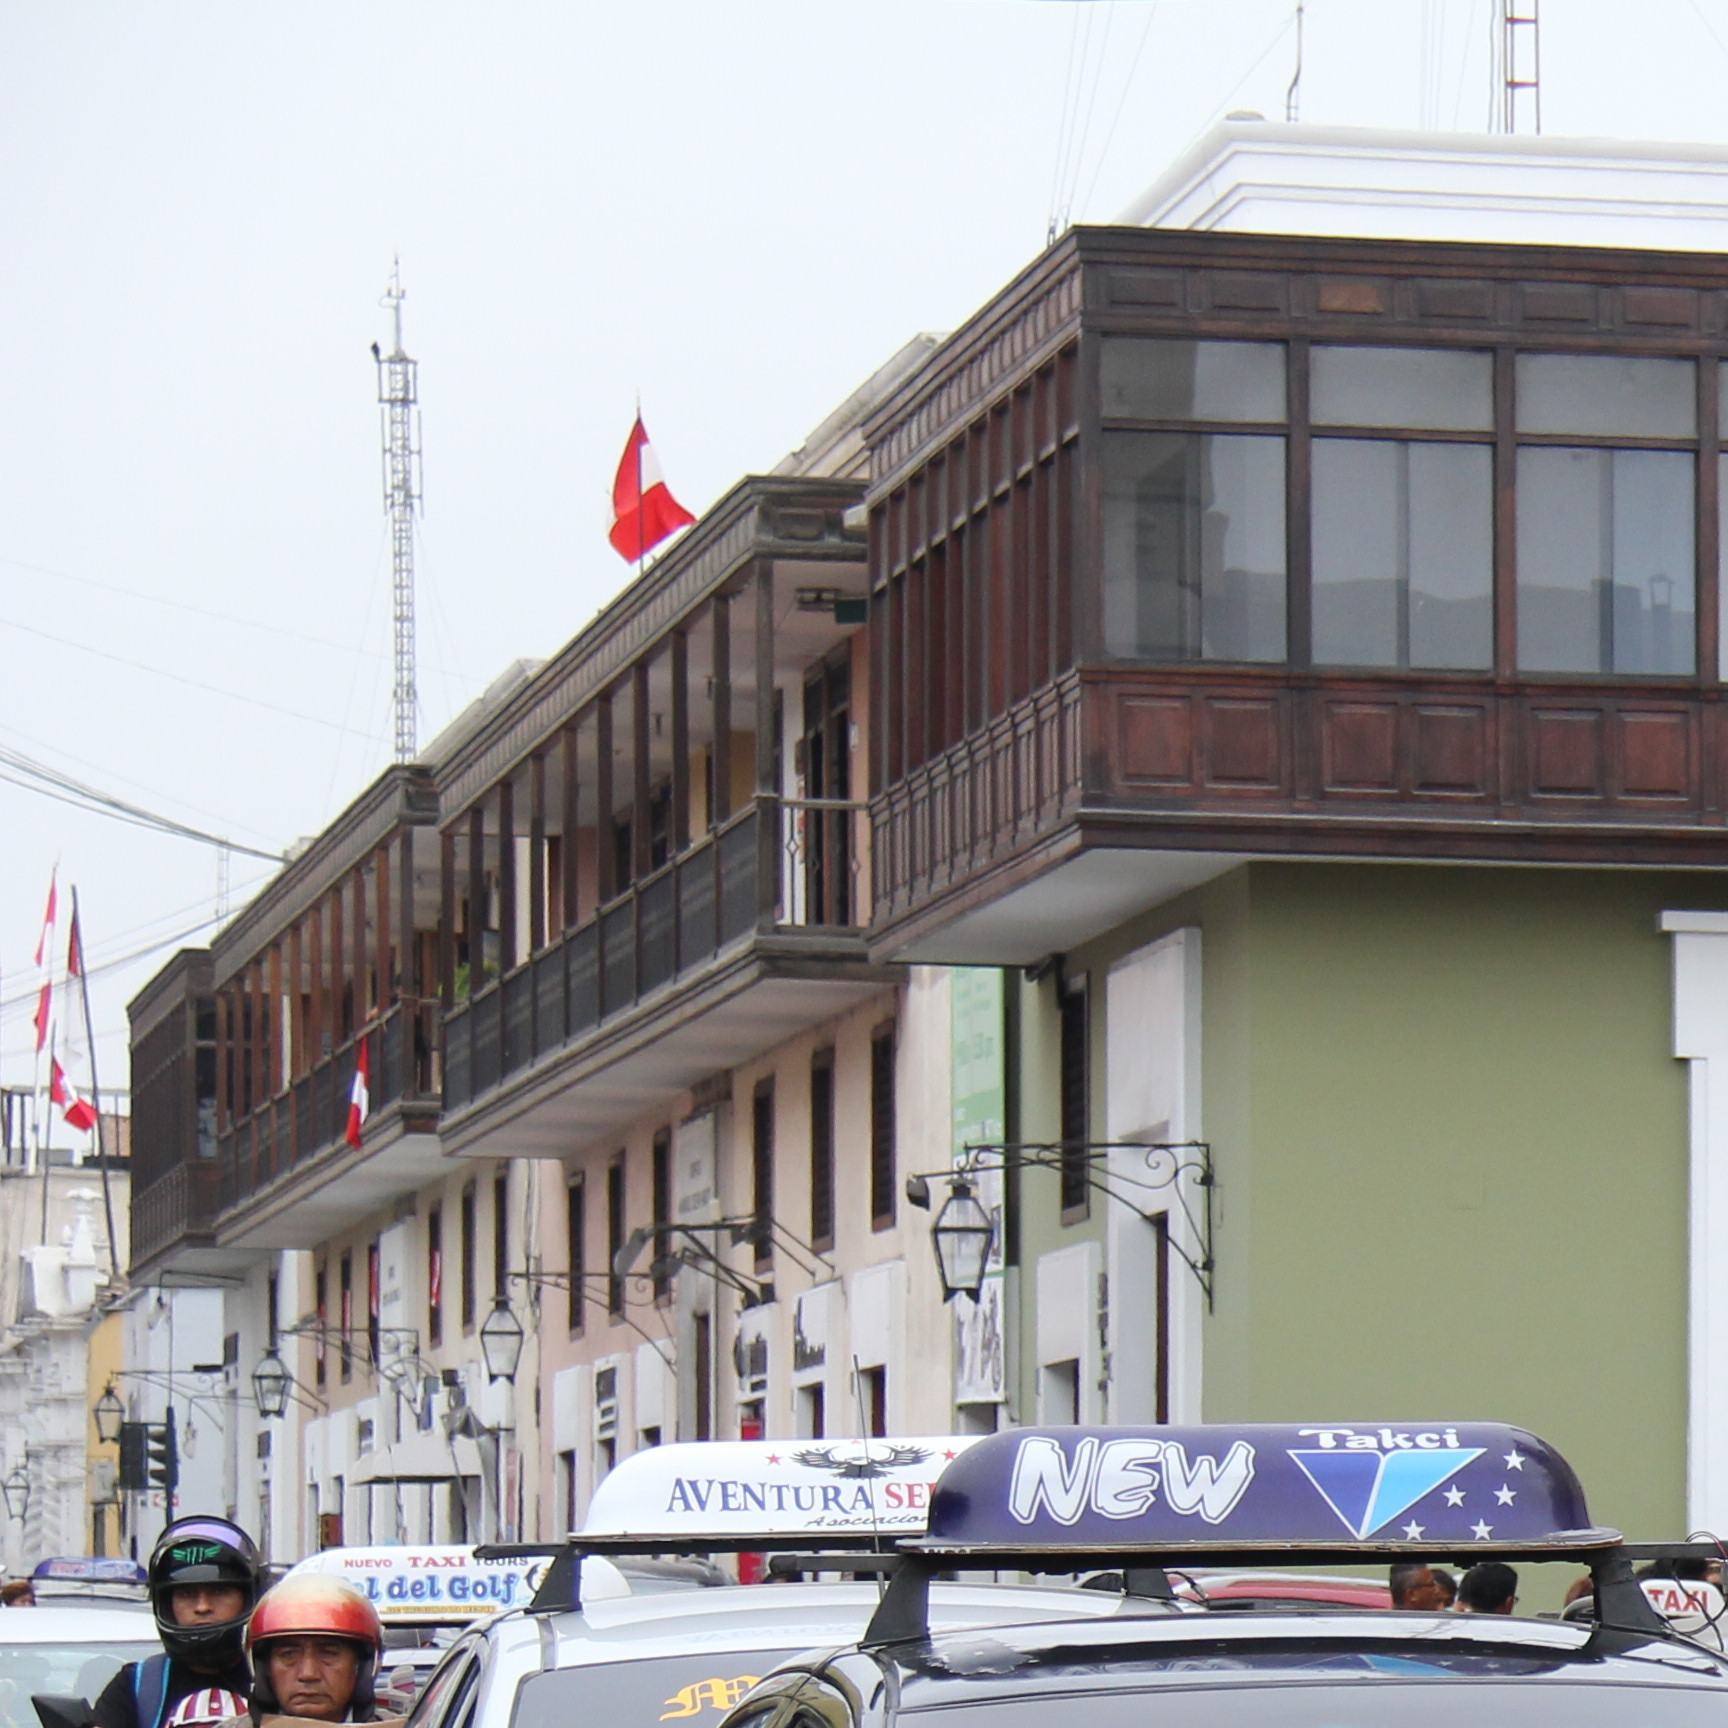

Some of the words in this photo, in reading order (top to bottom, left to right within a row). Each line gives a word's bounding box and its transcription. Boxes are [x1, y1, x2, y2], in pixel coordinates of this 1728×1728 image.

[1297, 1428, 1460, 1450] Takci
[1009, 1436, 1256, 1526] NEW
[665, 1477, 873, 1515] AVENTURA
[344, 1558, 393, 1569] NUEVO
[407, 1556, 466, 1568] TAXI
[475, 1556, 529, 1567] TOURS
[387, 1573, 443, 1602] del
[449, 1573, 521, 1606] Golf
[1647, 1589, 1709, 1612] TAXI
